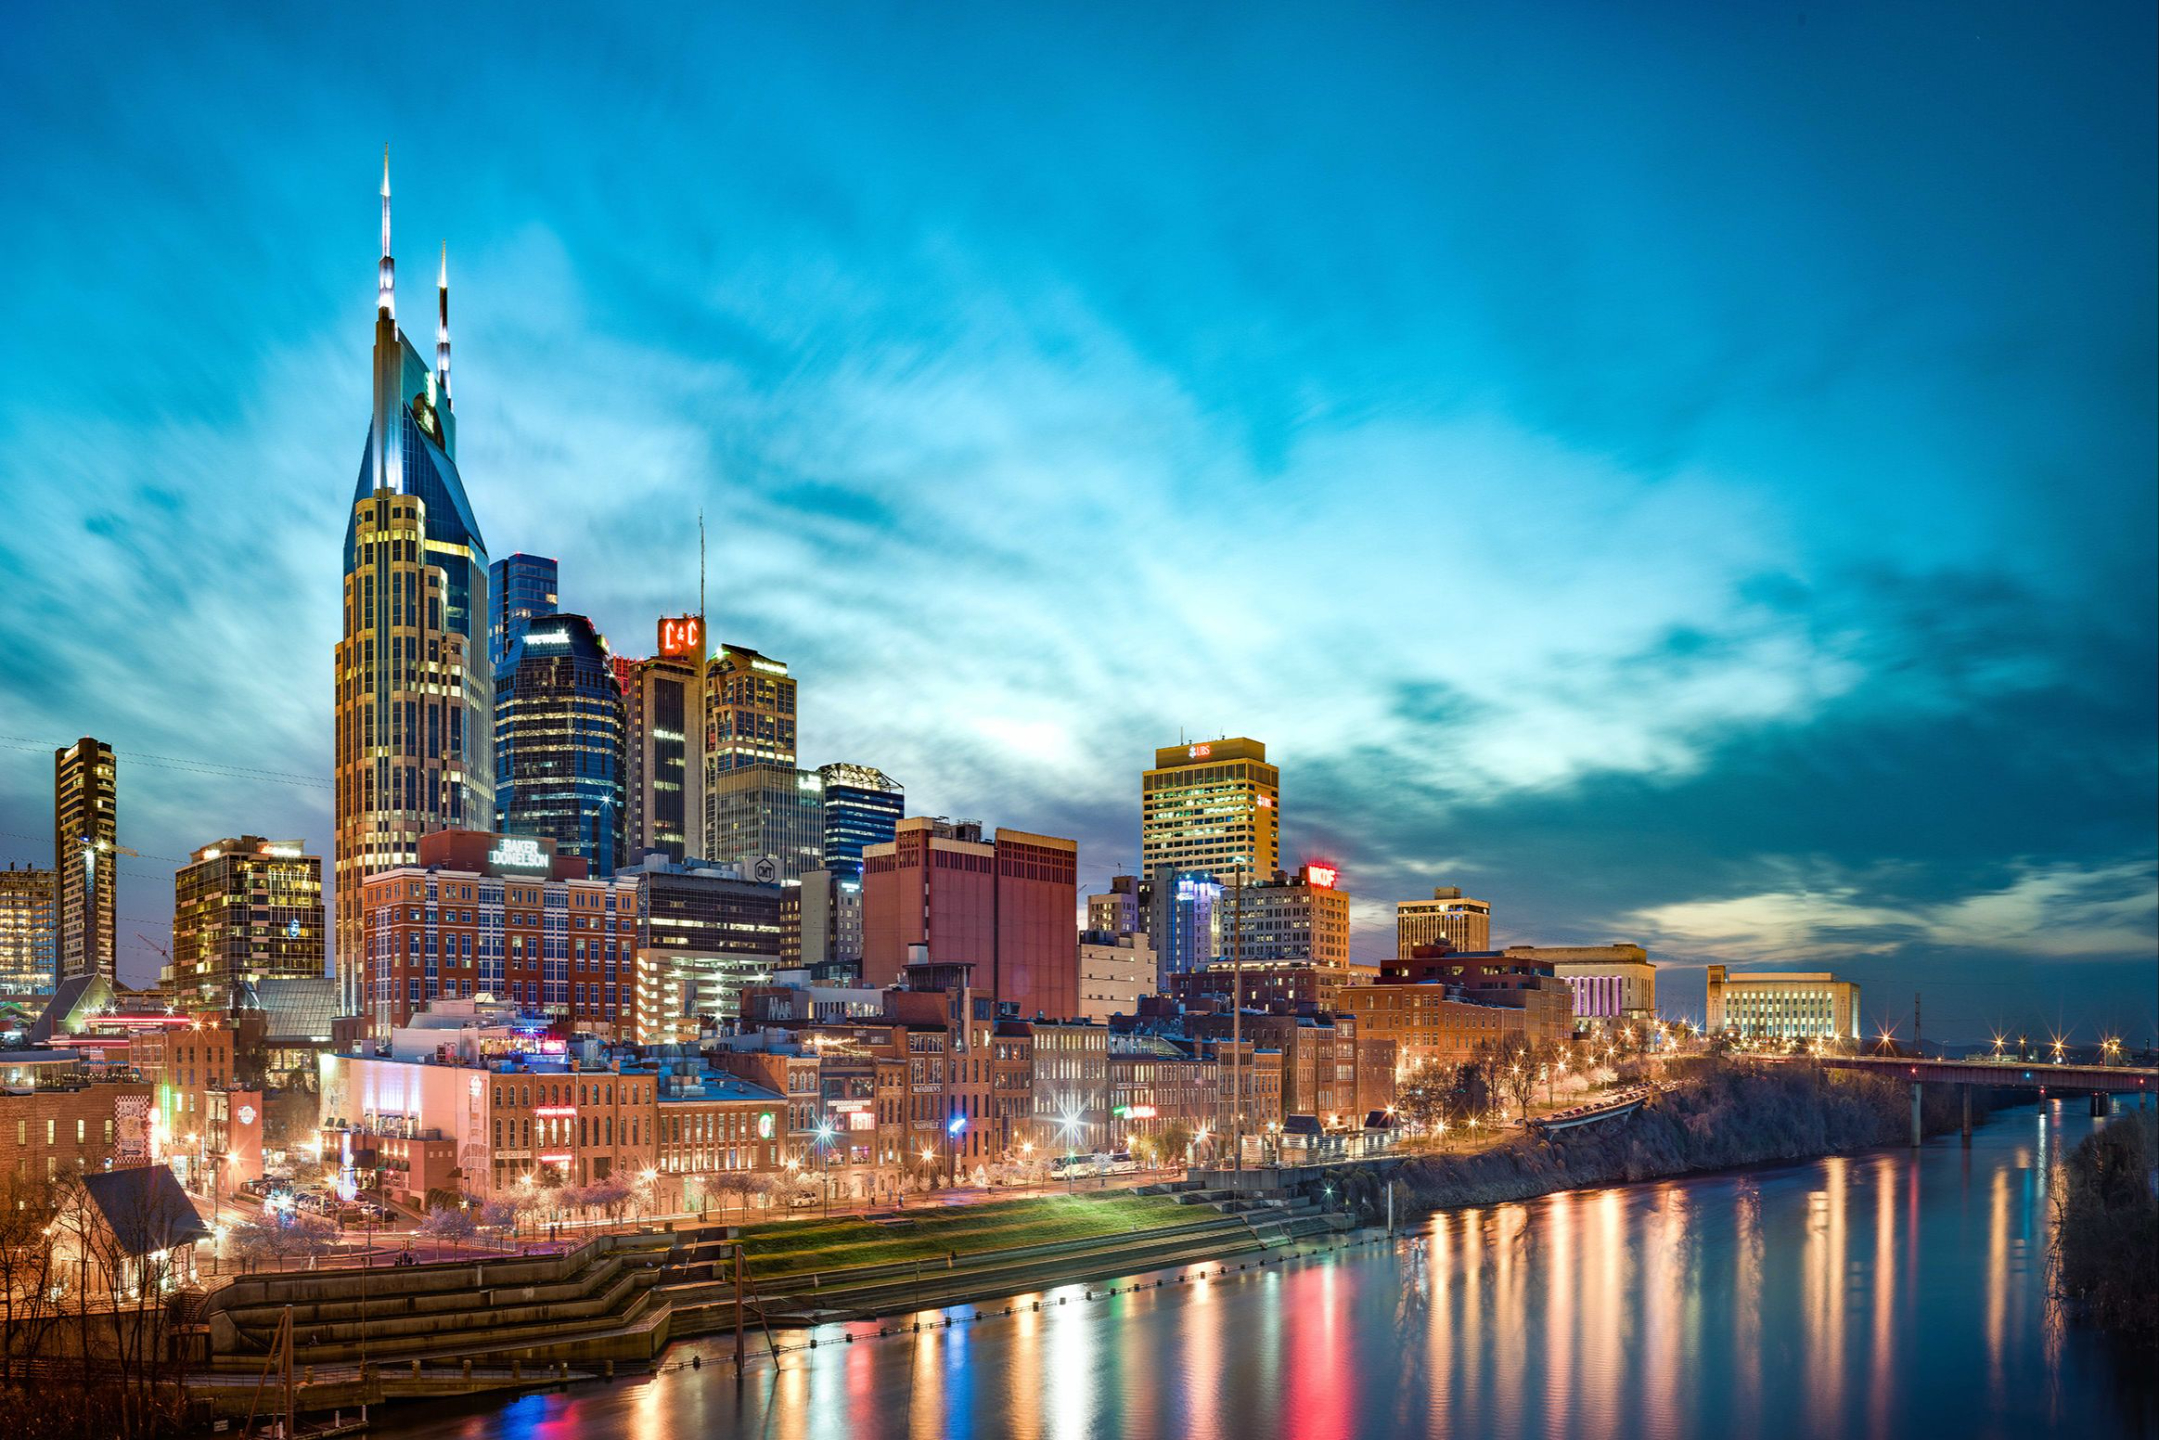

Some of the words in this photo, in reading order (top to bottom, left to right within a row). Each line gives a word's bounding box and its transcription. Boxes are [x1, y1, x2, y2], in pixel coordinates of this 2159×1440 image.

[1196, 745, 1211, 757] UBS
[500, 838, 539, 855] BAKER
[490, 850, 549, 868] DONELSON
[757, 865, 773, 879] CMT
